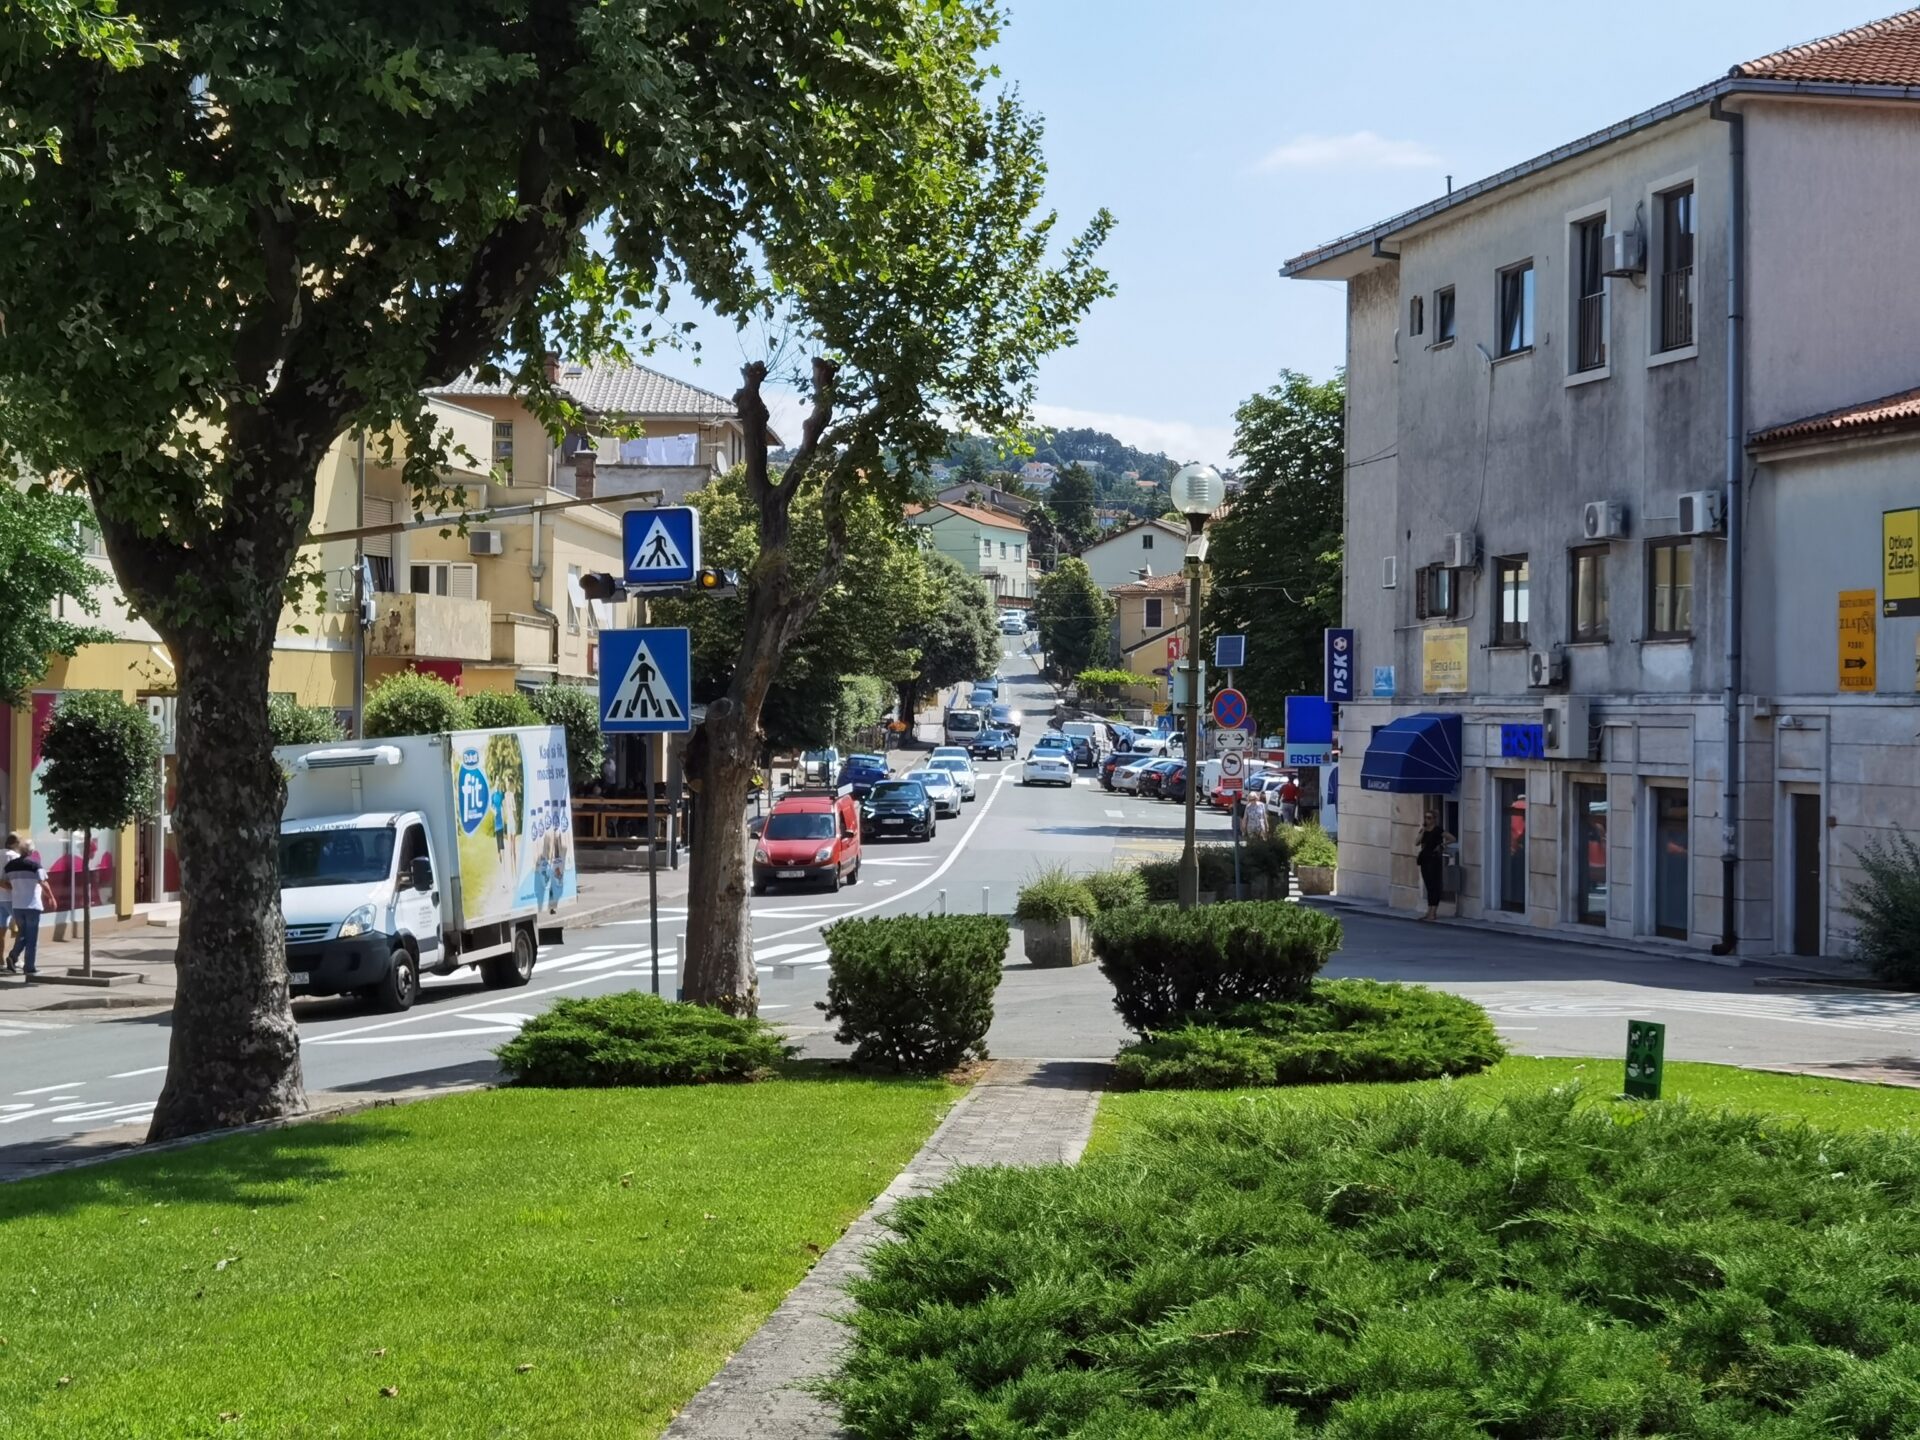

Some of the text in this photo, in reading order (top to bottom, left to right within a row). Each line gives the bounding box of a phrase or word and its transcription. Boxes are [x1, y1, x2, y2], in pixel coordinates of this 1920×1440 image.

[1889, 536, 1912, 552] Otkup
[1888, 551, 1914, 570] Zlata
[1333, 652, 1348, 694] PSK
[1290, 754, 1321, 764] ERSTE
[462, 773, 483, 823] fit
